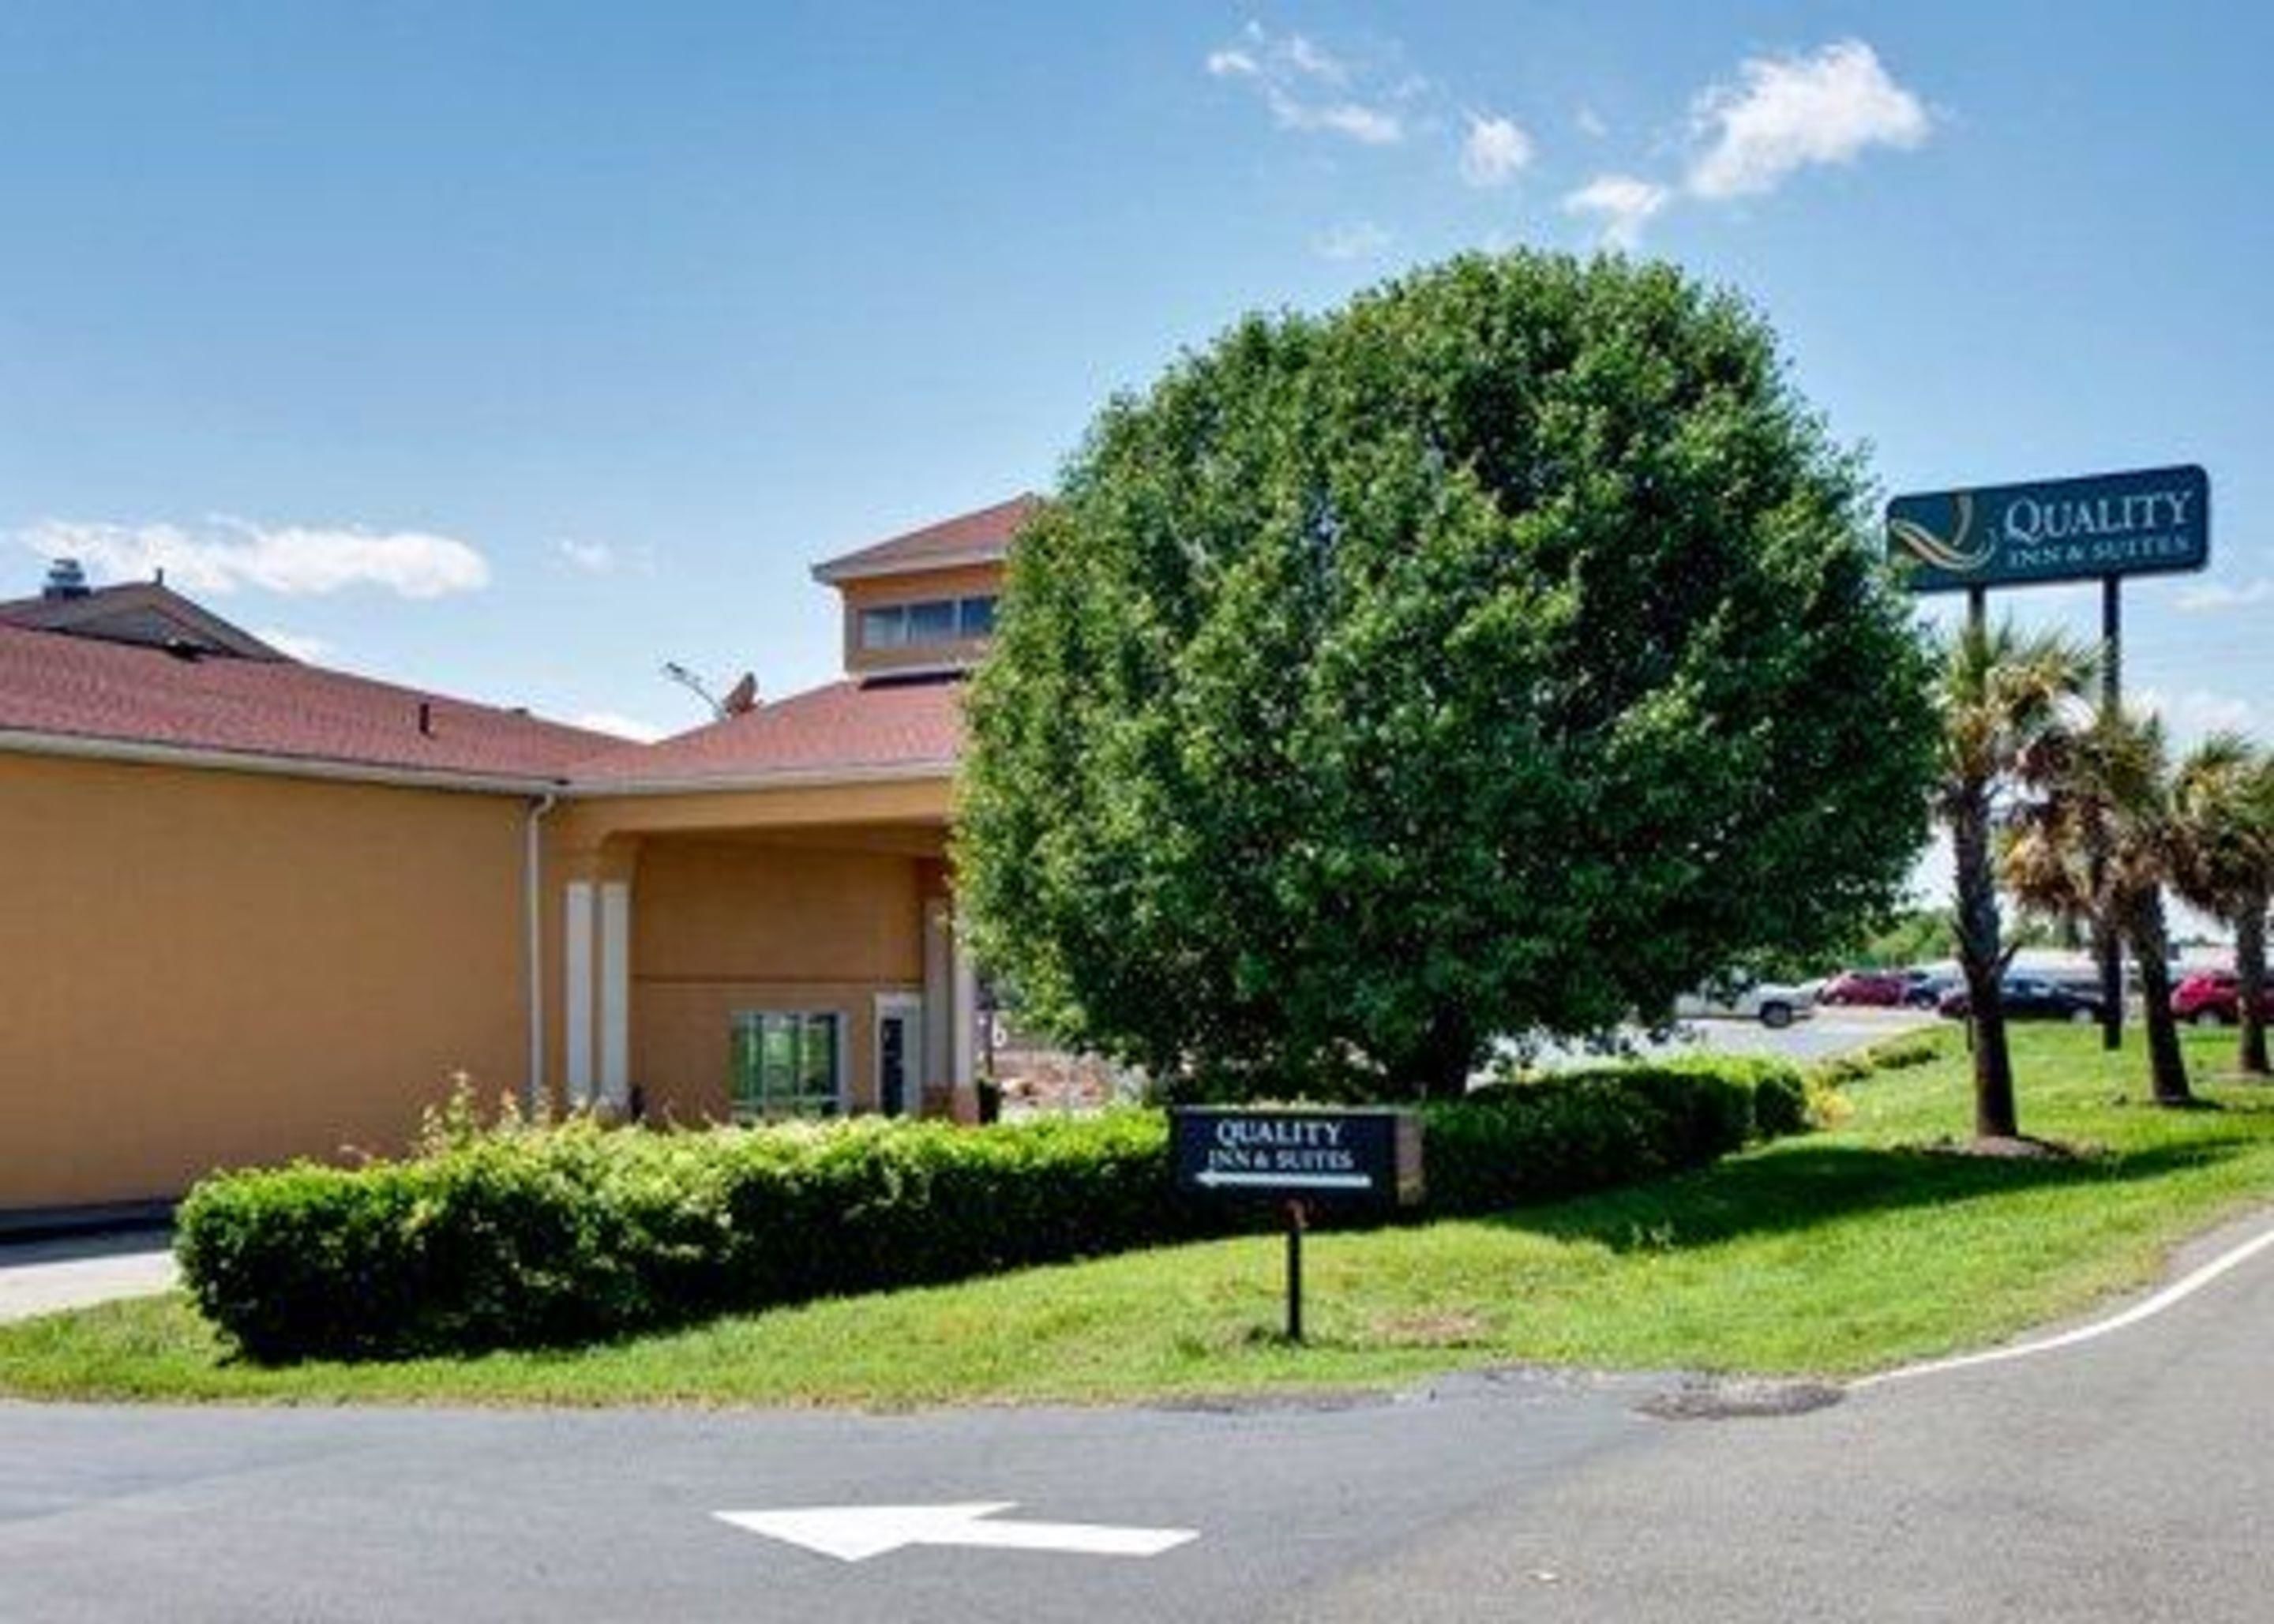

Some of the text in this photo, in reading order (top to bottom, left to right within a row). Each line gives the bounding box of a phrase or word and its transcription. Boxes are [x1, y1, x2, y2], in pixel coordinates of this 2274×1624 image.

[2005, 492, 2192, 546] QUALITY
[2009, 535, 2191, 568] INN & SUITES
[1216, 1120, 1342, 1147] QUALITY
[1208, 1150, 1354, 1170] INN & SUITES
